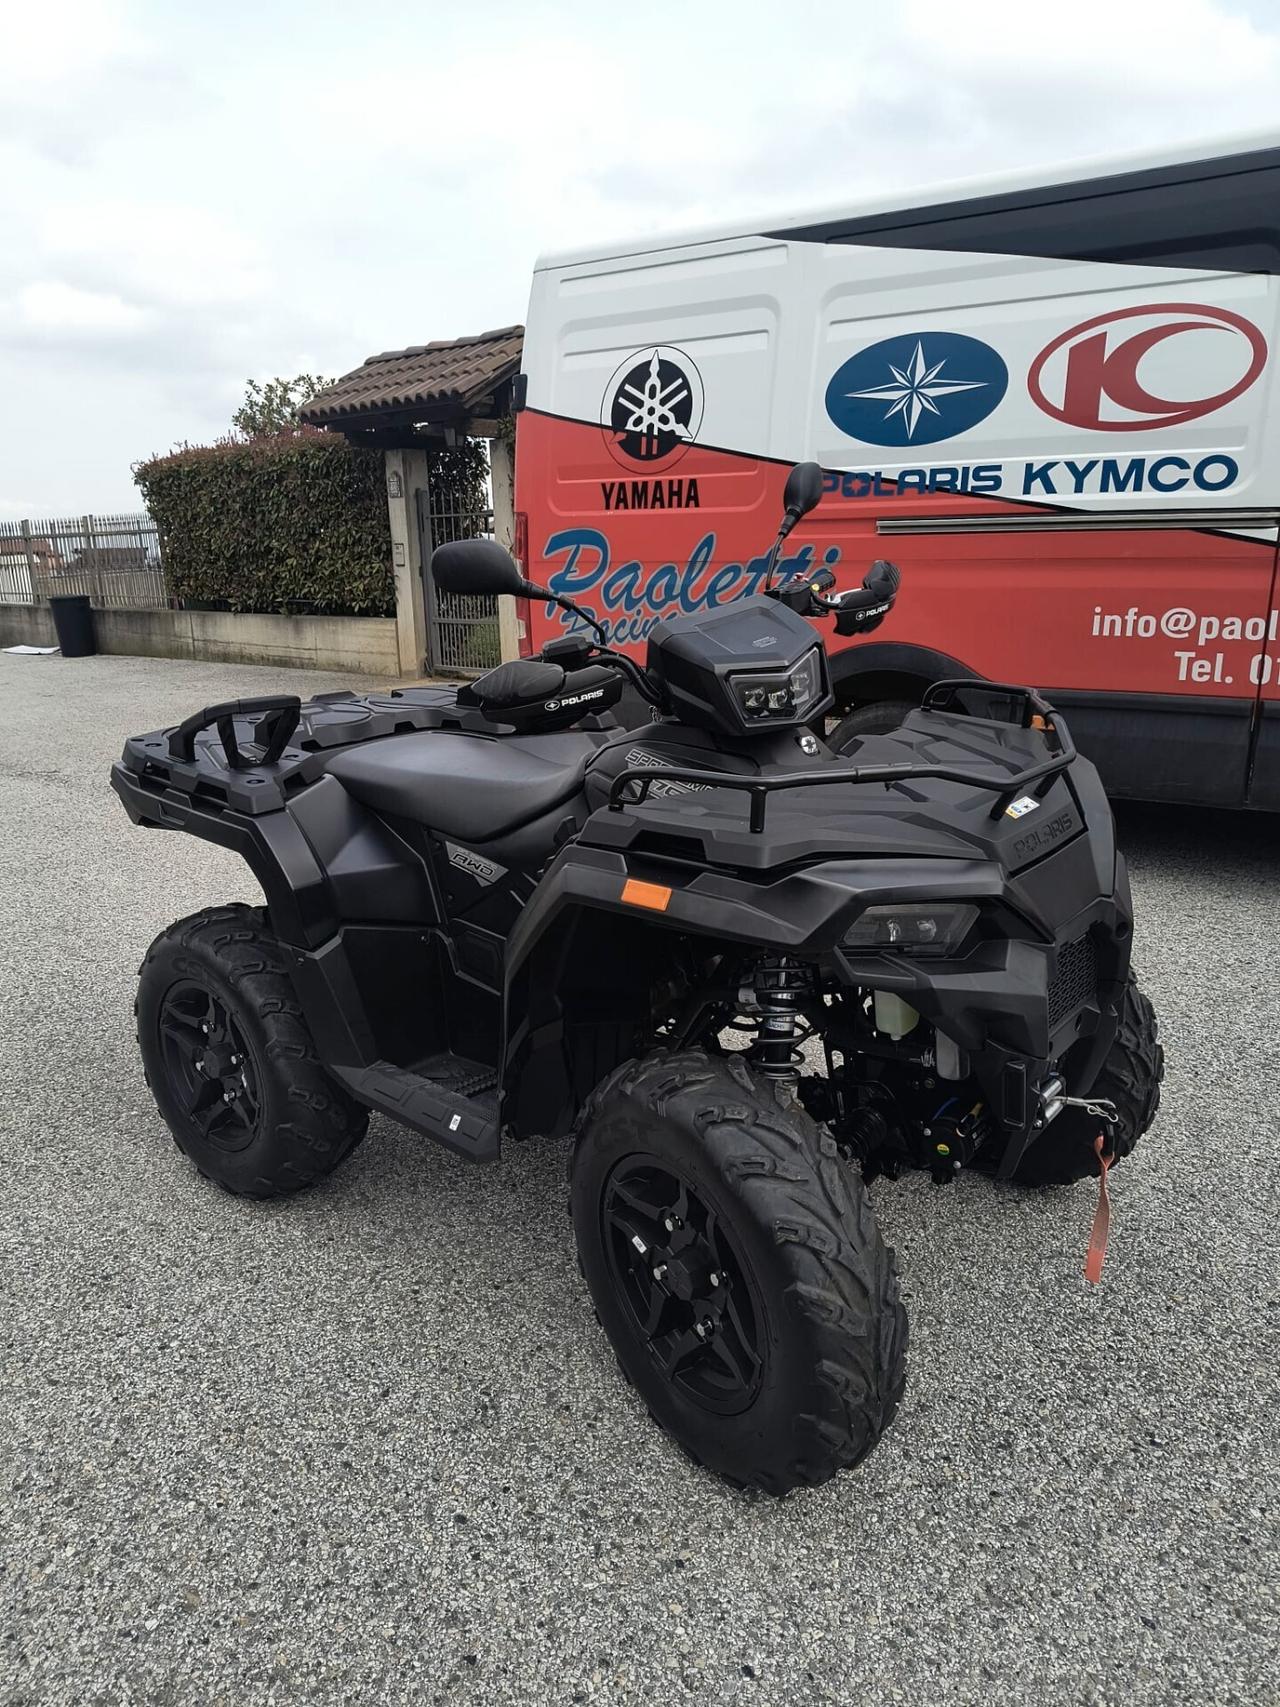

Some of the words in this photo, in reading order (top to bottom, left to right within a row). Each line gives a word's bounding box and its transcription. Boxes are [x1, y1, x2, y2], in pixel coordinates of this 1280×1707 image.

[1022, 454, 1239, 495] KYMCO
[601, 478, 700, 510] YAMAHA
[1092, 606, 1279, 646] info@paol
[1174, 651, 1233, 684] Tel.
[561, 689, 604, 707] POLARIS
[1013, 812, 1073, 860] POLARIS
